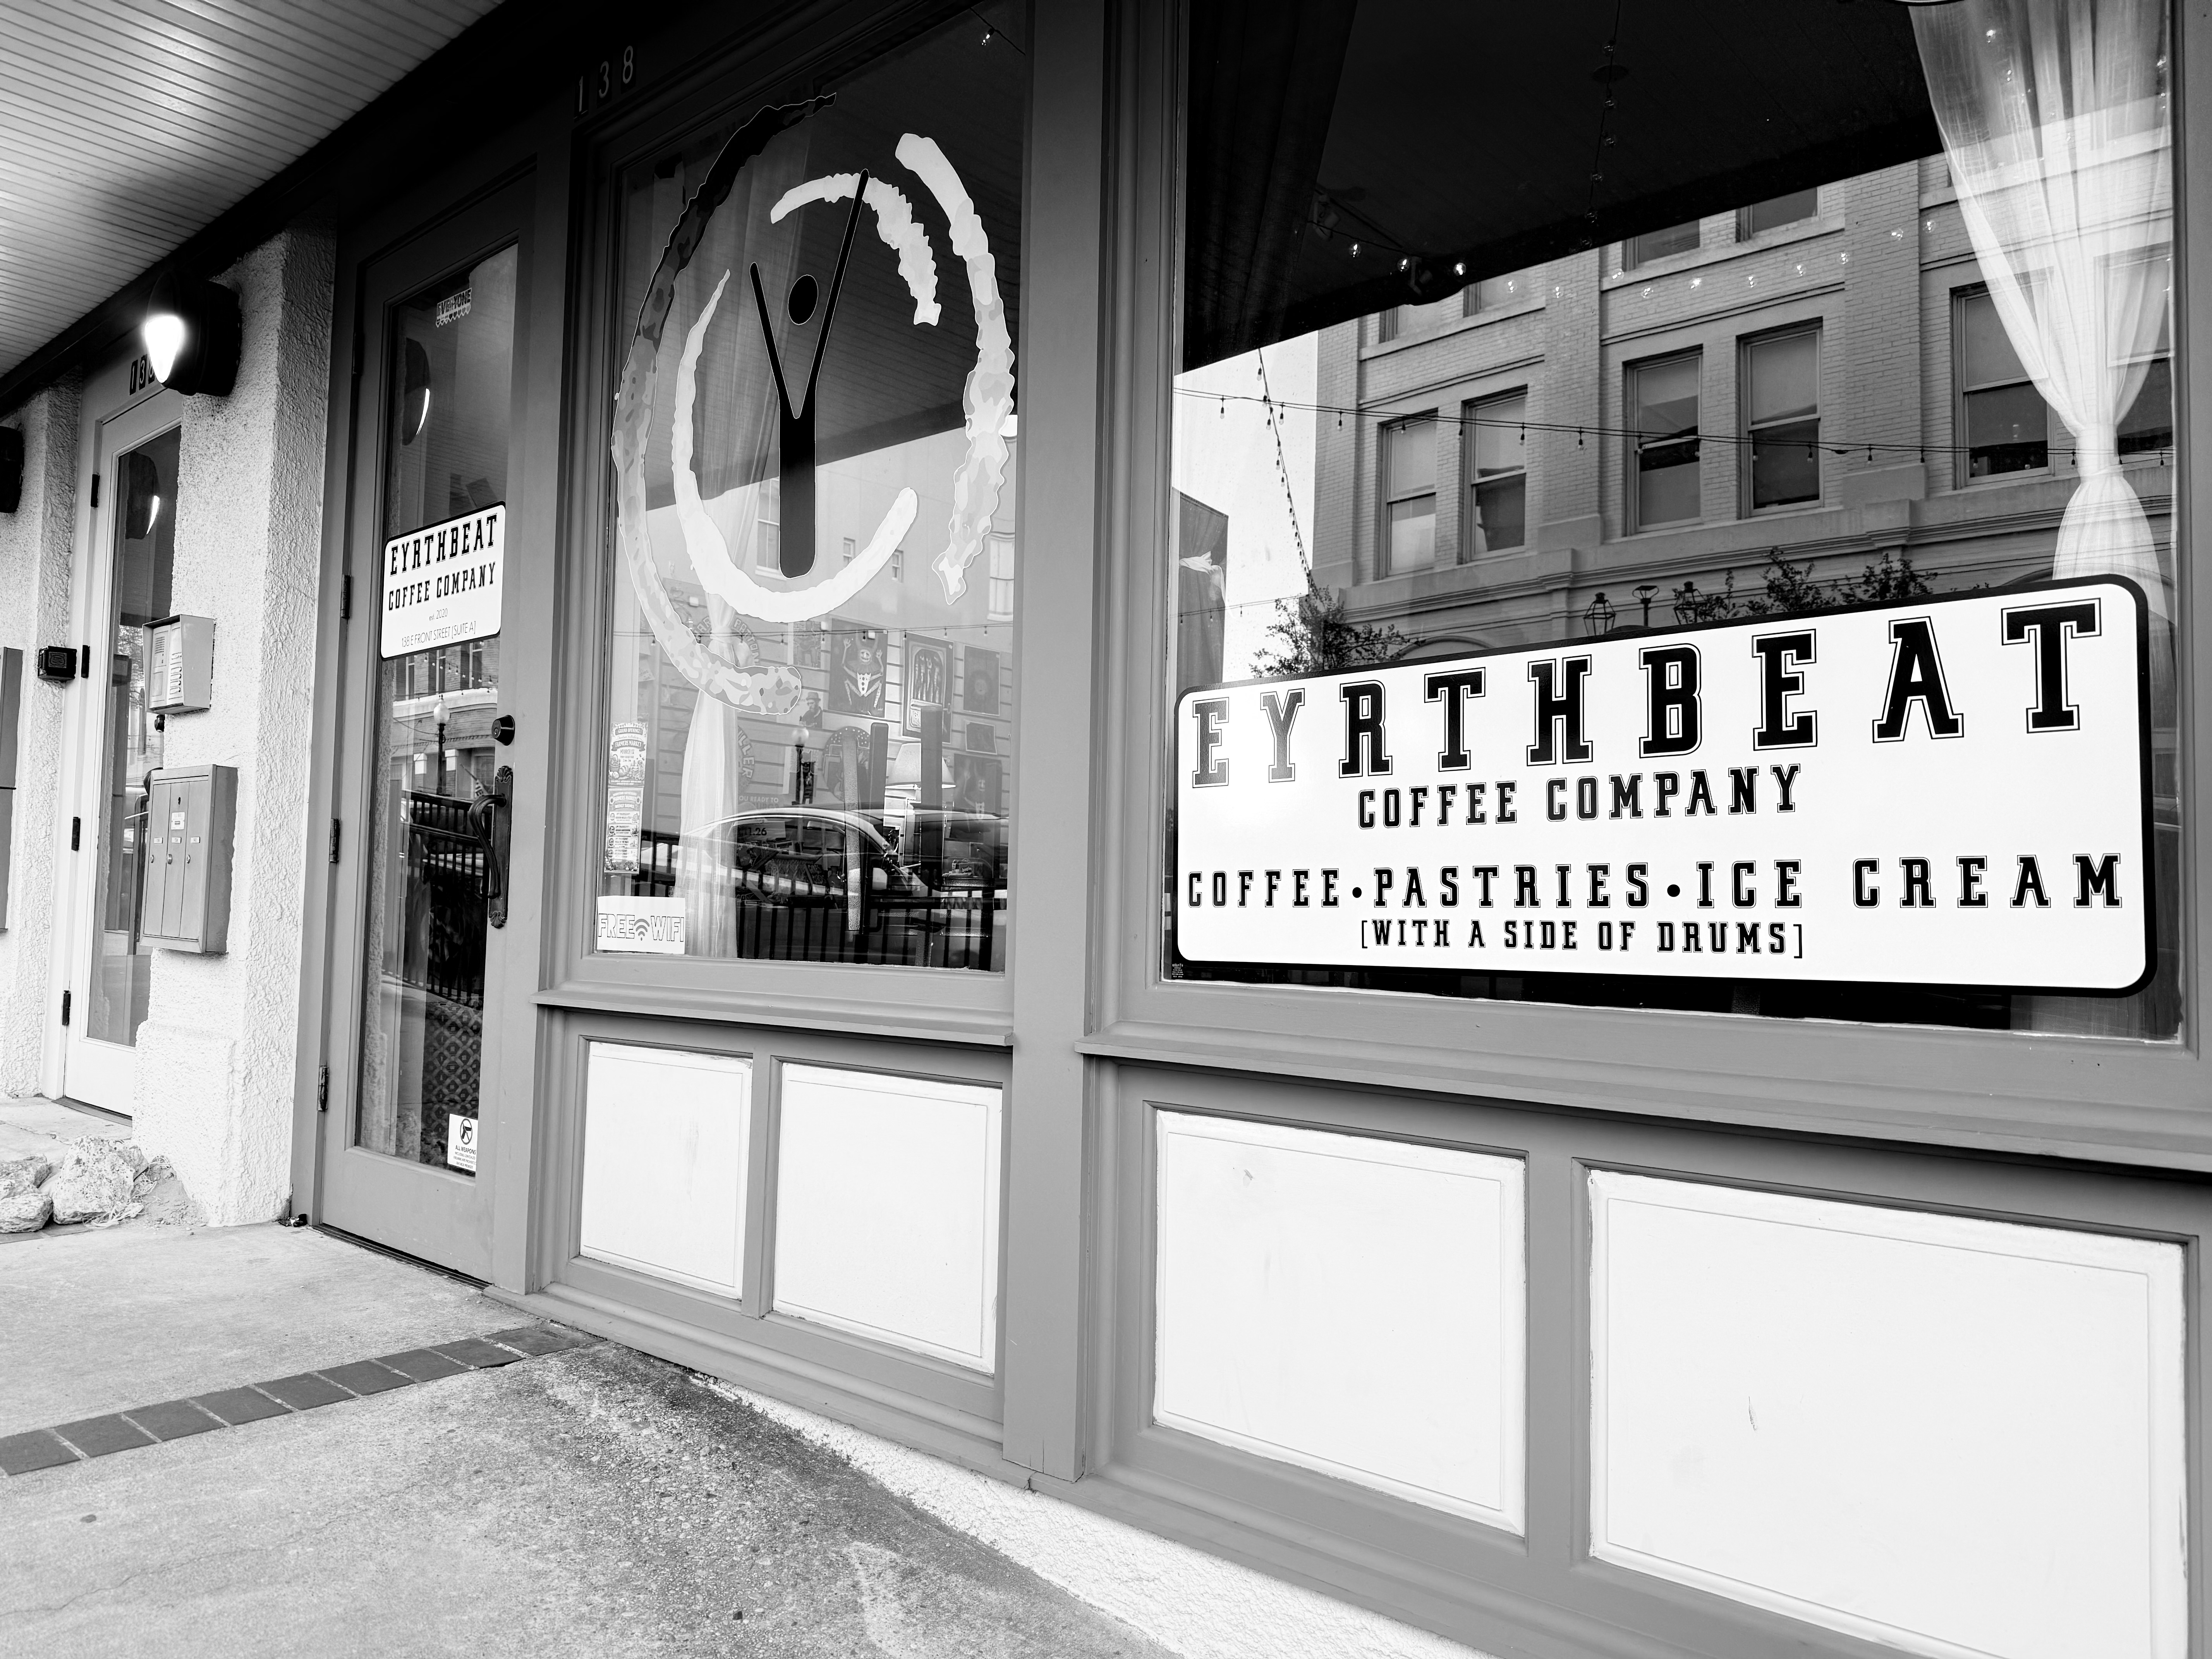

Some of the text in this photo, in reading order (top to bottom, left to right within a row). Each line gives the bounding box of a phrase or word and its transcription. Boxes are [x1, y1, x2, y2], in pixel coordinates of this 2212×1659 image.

[579, 45, 633, 112] 138
[437, 289, 471, 317] EVERYONE
[390, 513, 498, 577] EYRTHBEAT
[389, 561, 495, 611] COFFEE COMPANY
[411, 635, 414, 645] E
[415, 631, 433, 644] FRONT
[433, 627, 450, 640] STREET
[436, 608, 448, 619] 2020
[1192, 598, 2102, 788] EYRTHBEAT
[737, 730, 755, 779] ILLER
[1358, 764, 1800, 829] COFFEE COMPANY
[1853, 853, 2122, 908] CREAM
[598, 913, 684, 942] FREE WIFI
[1362, 920, 1802, 958] [WITH A SIDE OF DRUMS]
[461, 1146, 476, 1155] WEAPONS
